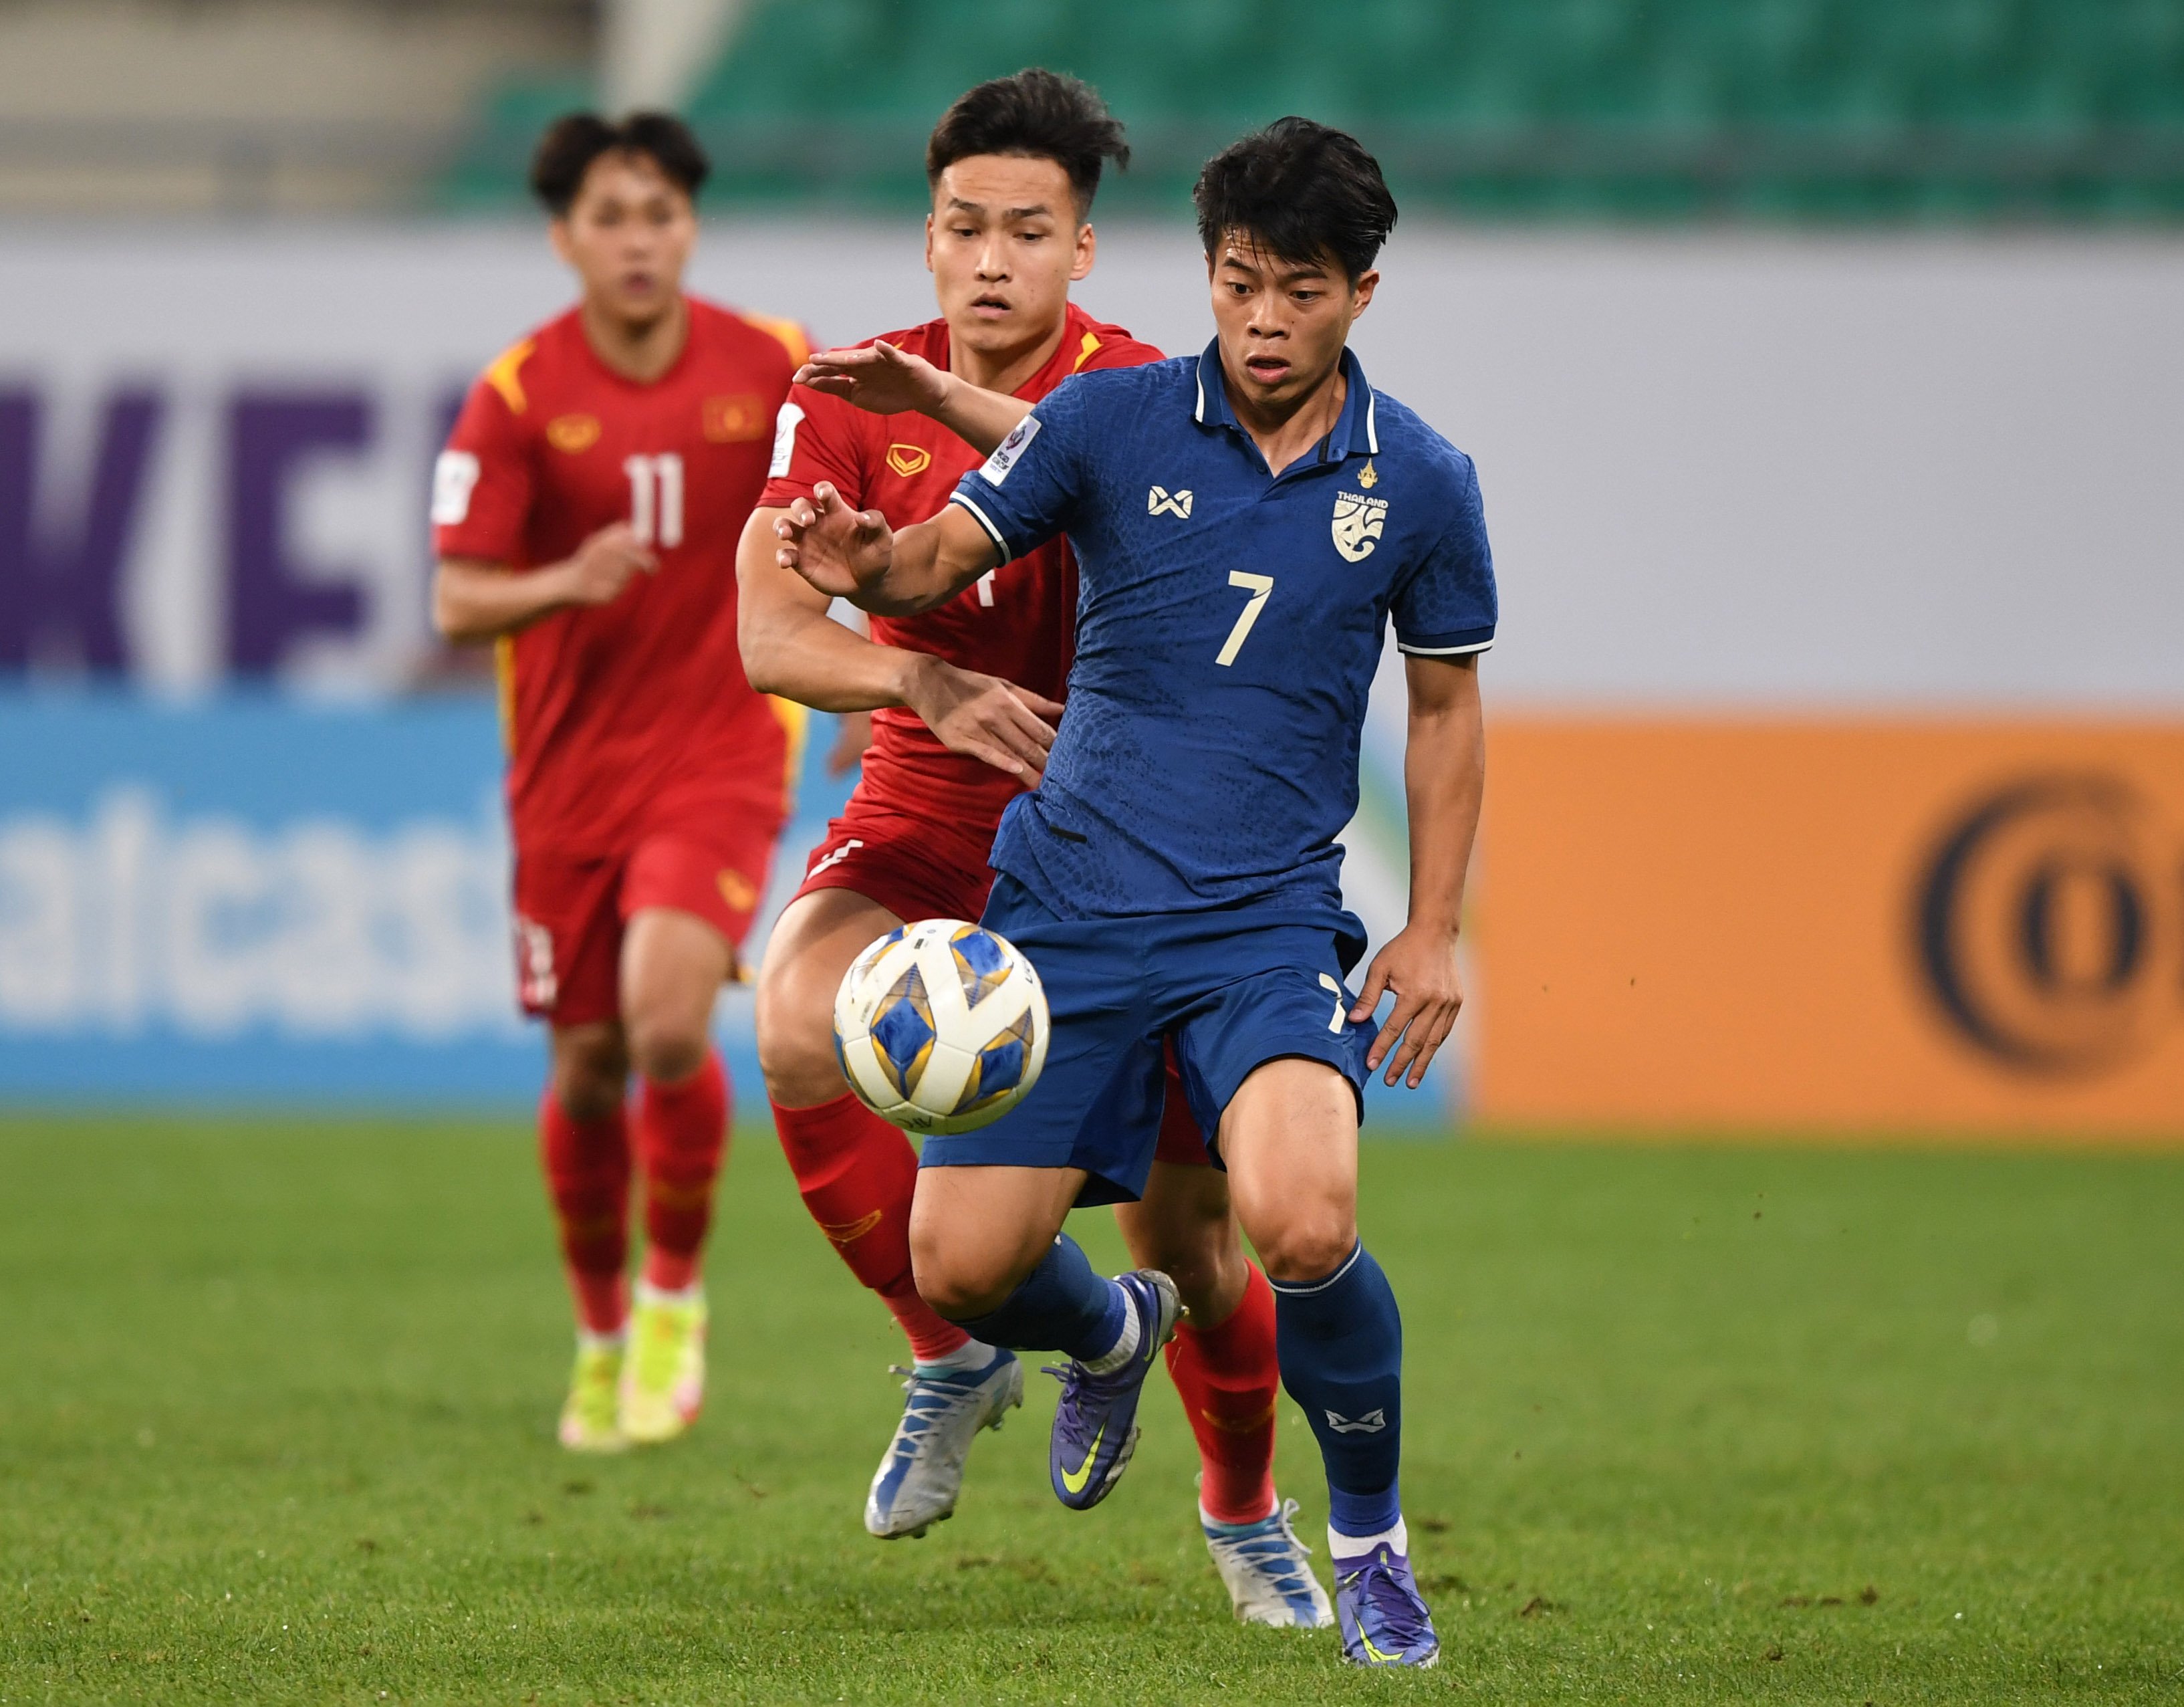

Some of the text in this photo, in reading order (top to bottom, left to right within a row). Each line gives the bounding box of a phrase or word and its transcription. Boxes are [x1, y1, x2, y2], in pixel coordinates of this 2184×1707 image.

[623, 452, 683, 547] 11
[1337, 490, 1389, 509] THAILAND
[1215, 570, 1274, 667] 7
[1318, 972, 1346, 1034] 7
